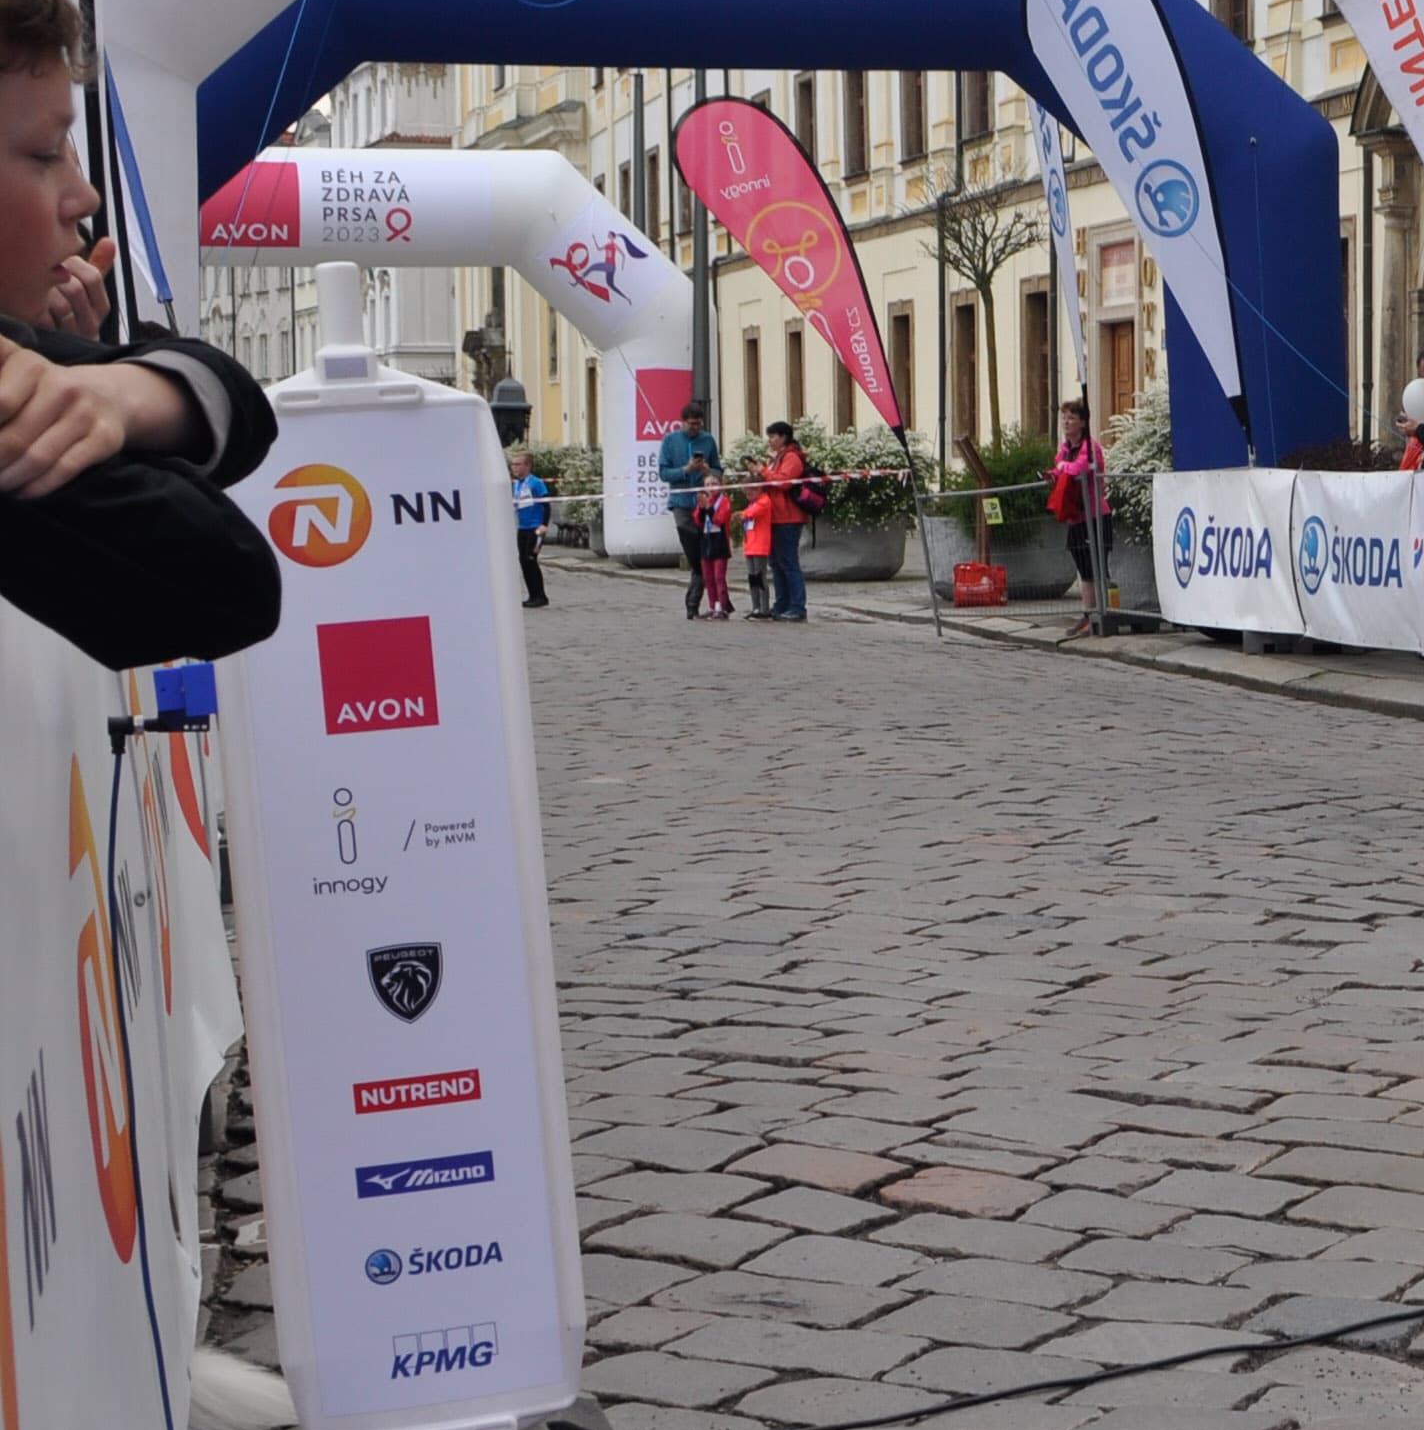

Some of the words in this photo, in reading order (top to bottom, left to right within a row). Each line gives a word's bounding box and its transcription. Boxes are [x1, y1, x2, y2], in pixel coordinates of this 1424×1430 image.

[321, 168, 364, 183] BĚH
[374, 170, 401, 184] ZA
[321, 185, 410, 202] ZDRAVÁ
[322, 207, 378, 222] PRSA
[210, 222, 289, 241] AVON
[322, 226, 380, 243] 2023
[391, 489, 463, 526] NN
[1197, 515, 1272, 579] ŠKODA
[1331, 525, 1403, 589] ŠKODA
[336, 696, 426, 725] AVON
[424, 819, 476, 834] Powered
[425, 836, 440, 849] by
[445, 832, 476, 845] MVM
[313, 875, 389, 896] innogy
[374, 948, 435, 963] PEUGEOT
[360, 1075, 476, 1108] NUTREND
[408, 1241, 504, 1276] ŠKODA
[391, 1340, 495, 1380] KPMG
